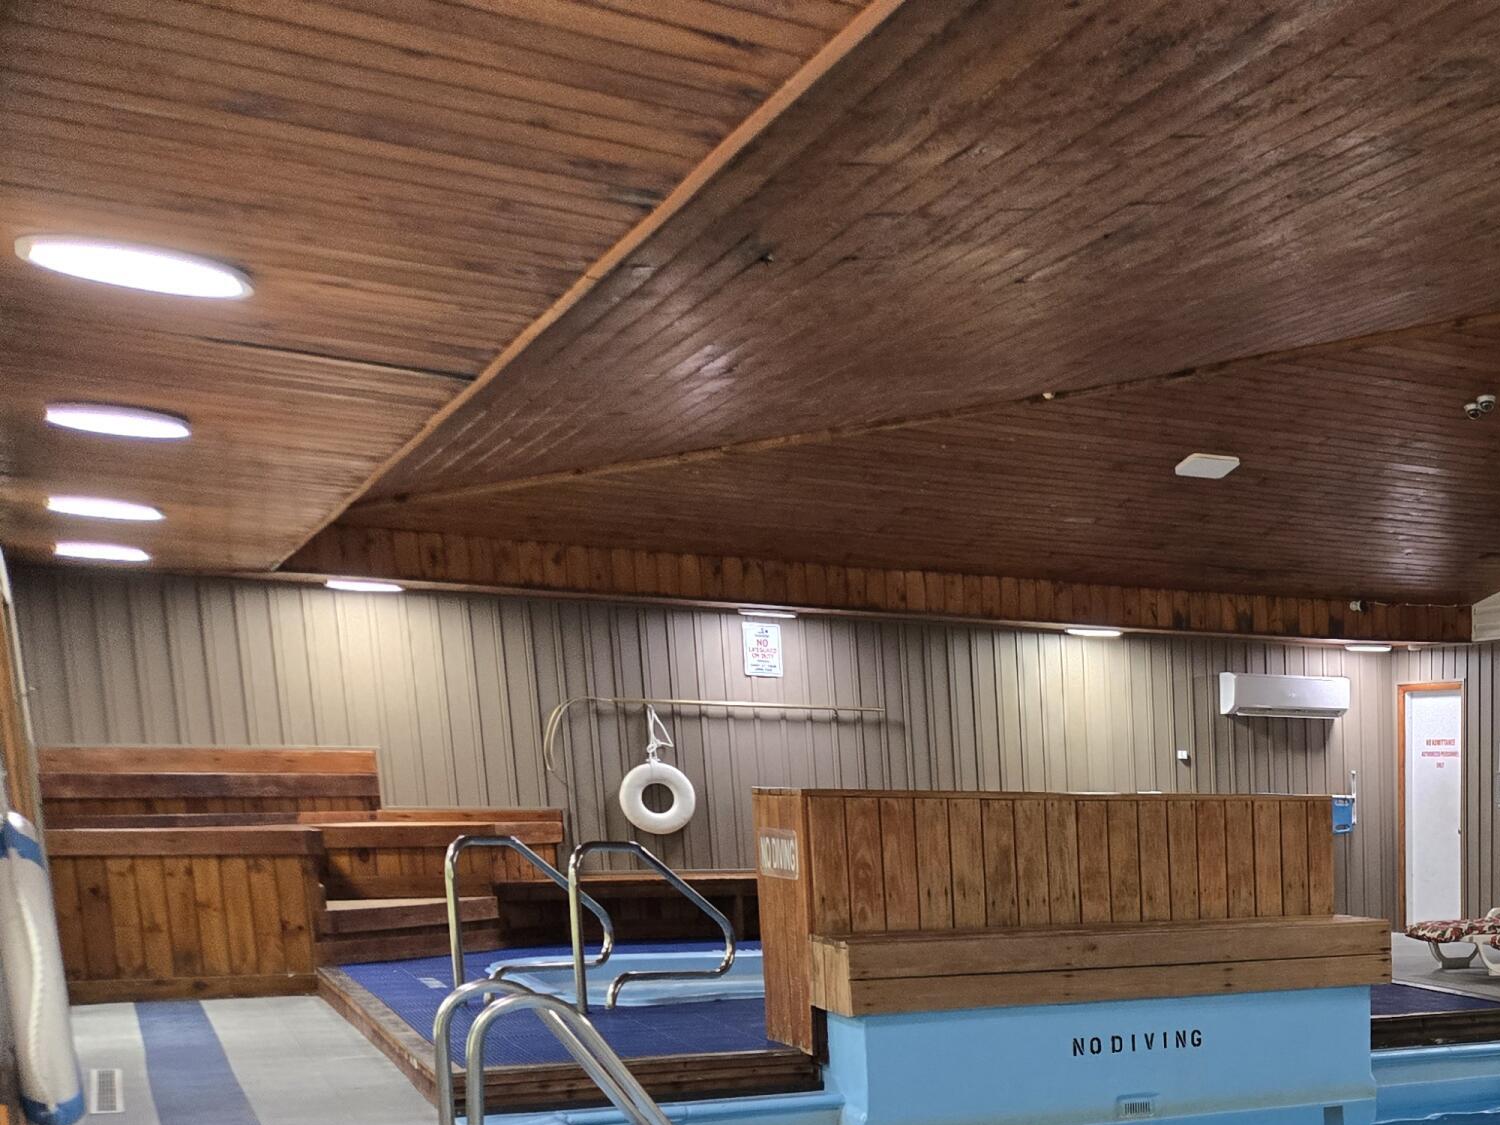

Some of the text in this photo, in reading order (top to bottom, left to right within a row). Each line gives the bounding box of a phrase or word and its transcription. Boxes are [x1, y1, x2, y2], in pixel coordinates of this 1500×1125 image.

[757, 639, 769, 648] NO
[760, 836, 796, 872] NO DIVING
[1072, 1029, 1203, 1057] NO DIVING
